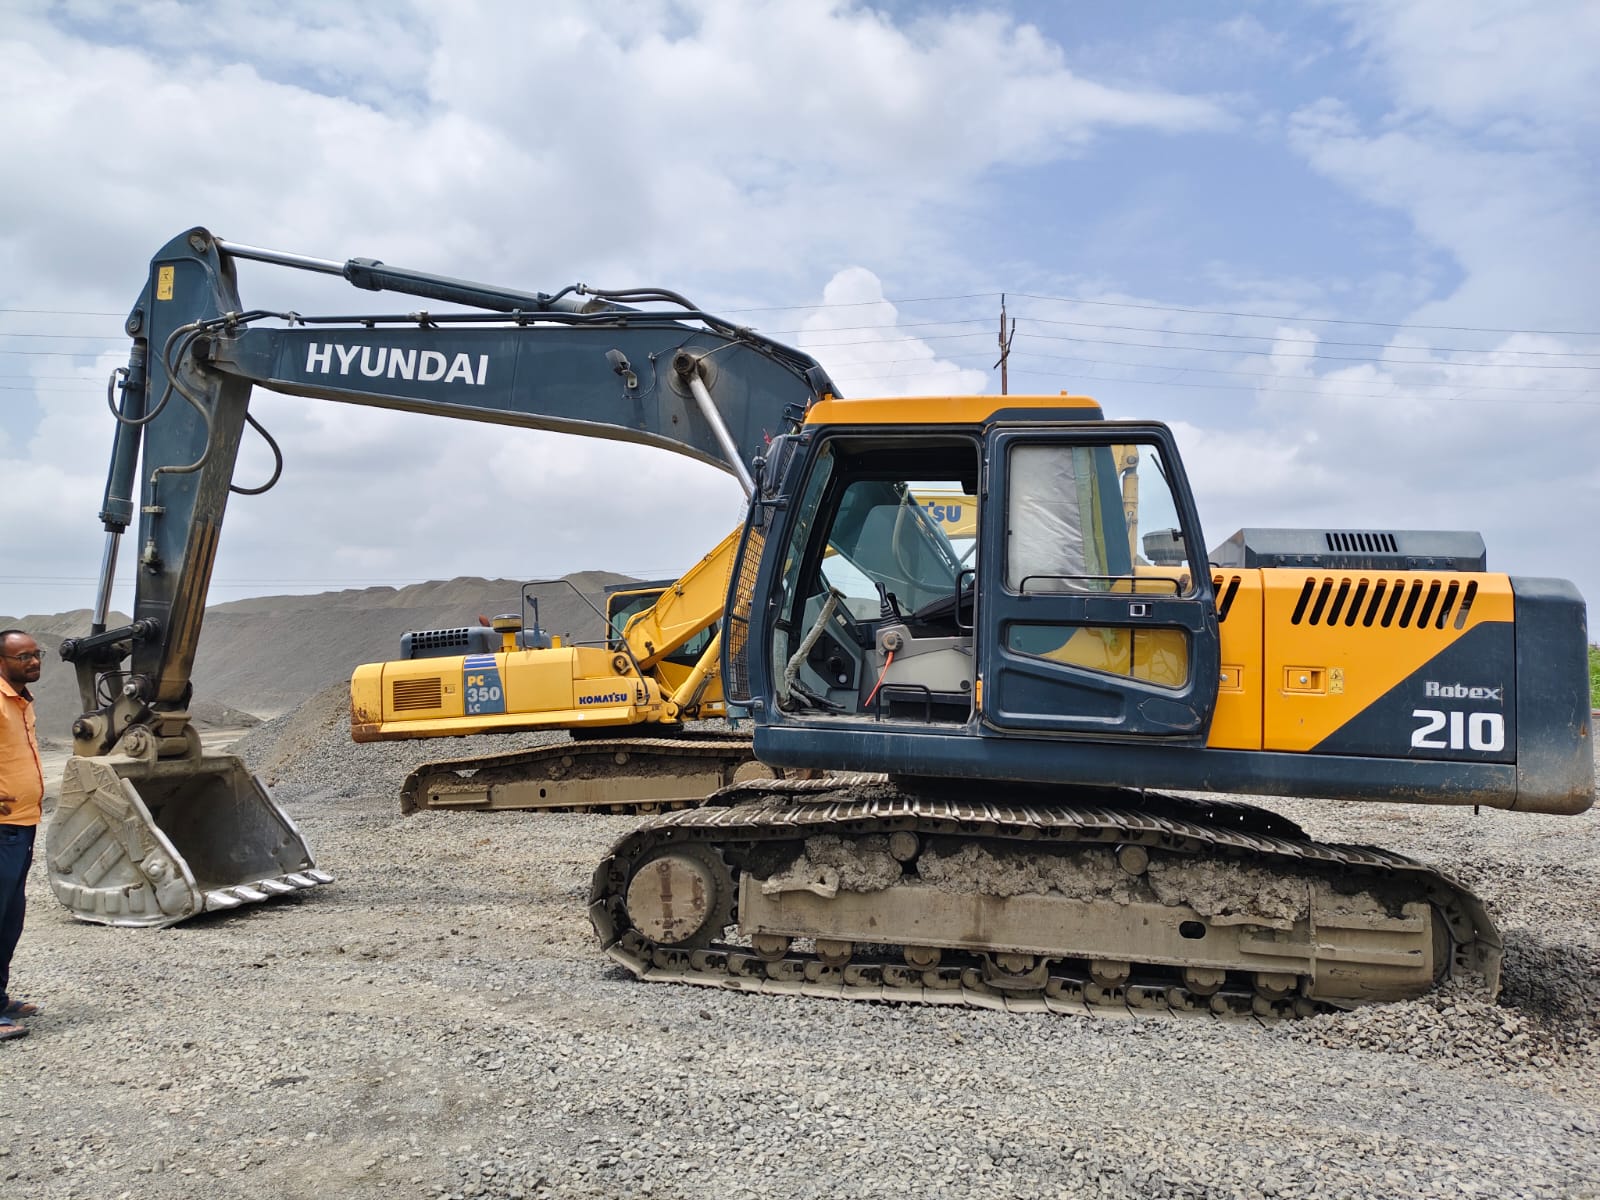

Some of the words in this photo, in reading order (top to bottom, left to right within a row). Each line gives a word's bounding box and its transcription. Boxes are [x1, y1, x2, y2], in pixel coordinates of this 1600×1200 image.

[305, 342, 489, 385] HYUNDAI
[467, 675, 485, 687] PC
[467, 686, 500, 702] 350
[579, 692, 628, 704] KOMATSU
[1425, 681, 1502, 700] Robex
[468, 703, 481, 713] LC
[1411, 709, 1505, 752] 210
